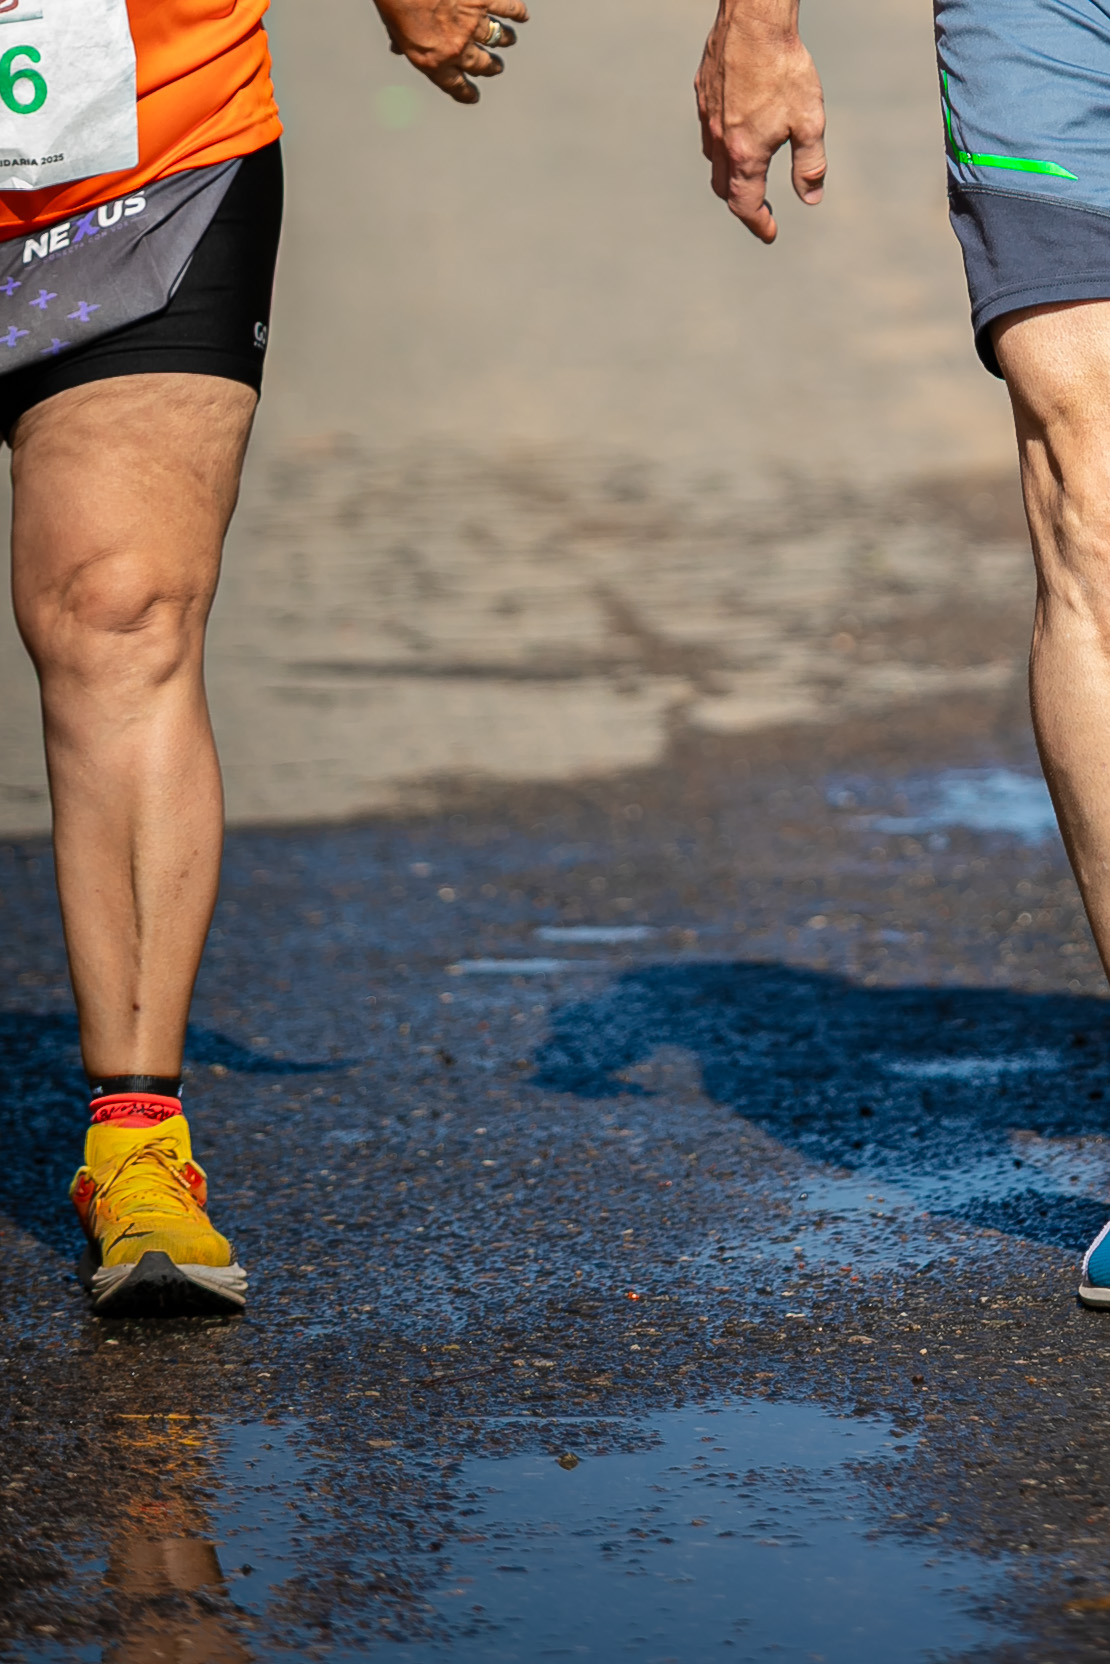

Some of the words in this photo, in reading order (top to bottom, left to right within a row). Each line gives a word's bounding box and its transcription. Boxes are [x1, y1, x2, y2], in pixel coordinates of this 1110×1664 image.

[0, 44, 48, 115] 6
[41, 152, 65, 165] 2025
[22, 190, 147, 264] NEXUS
